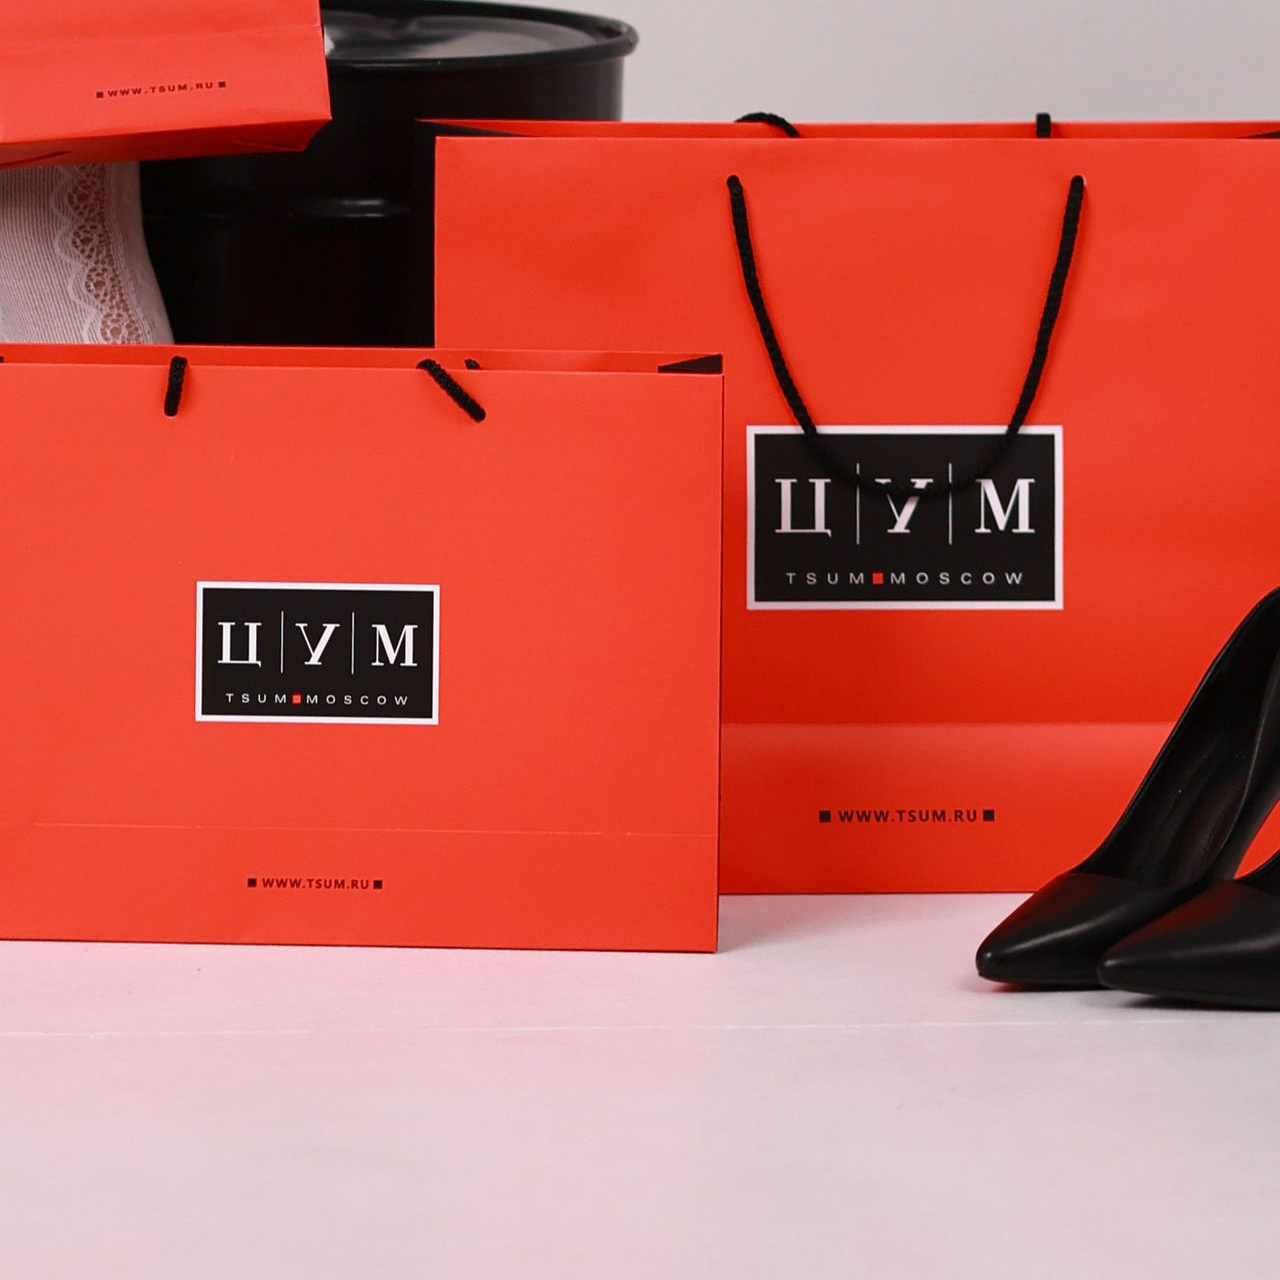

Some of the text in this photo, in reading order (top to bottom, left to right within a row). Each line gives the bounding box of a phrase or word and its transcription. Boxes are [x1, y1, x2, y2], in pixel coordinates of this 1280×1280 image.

[107, 82, 213, 97] WWW.TSUM.RU
[775, 478, 1035, 538] ЦУМ
[786, 572, 1023, 585] TSUM MOSCOW
[217, 622, 419, 668] ЦУМ
[226, 693, 408, 706] TSUM MOSCOW
[838, 809, 977, 822] WWW.TSUM.RU
[262, 878, 369, 889] WWW.TSUM.RU
